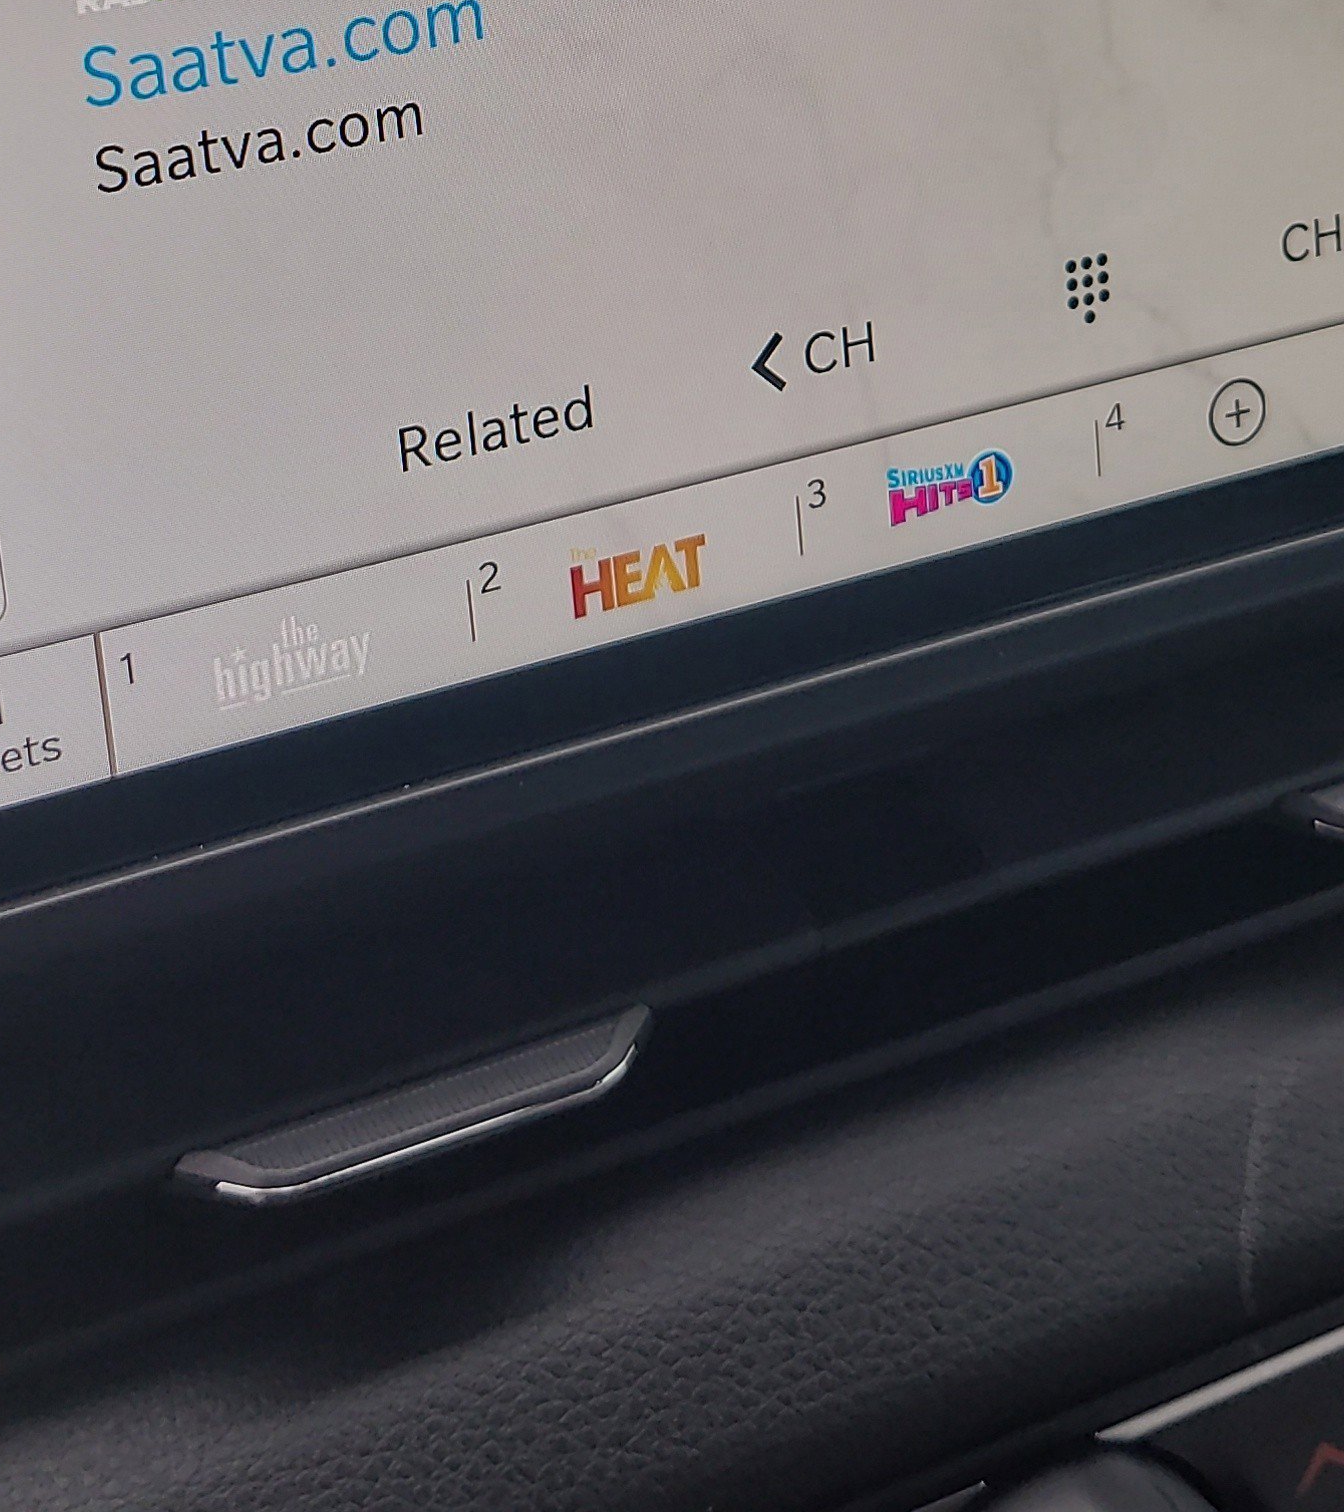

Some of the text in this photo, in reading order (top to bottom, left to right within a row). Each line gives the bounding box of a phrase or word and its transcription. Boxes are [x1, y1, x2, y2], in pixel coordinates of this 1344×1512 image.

[94, 100, 425, 193] Saatva.com
[1281, 213, 1343, 262] CH
[805, 321, 877, 374] CH
[398, 384, 595, 472] Related
[1105, 403, 1125, 432] 4
[808, 479, 827, 509] 3
[889, 454, 1003, 527] HITS 1
[479, 561, 502, 594] 2
[570, 534, 707, 620] HEAT
[280, 616, 319, 648] the
[119, 654, 136, 685] 1
[213, 630, 373, 703] highway
